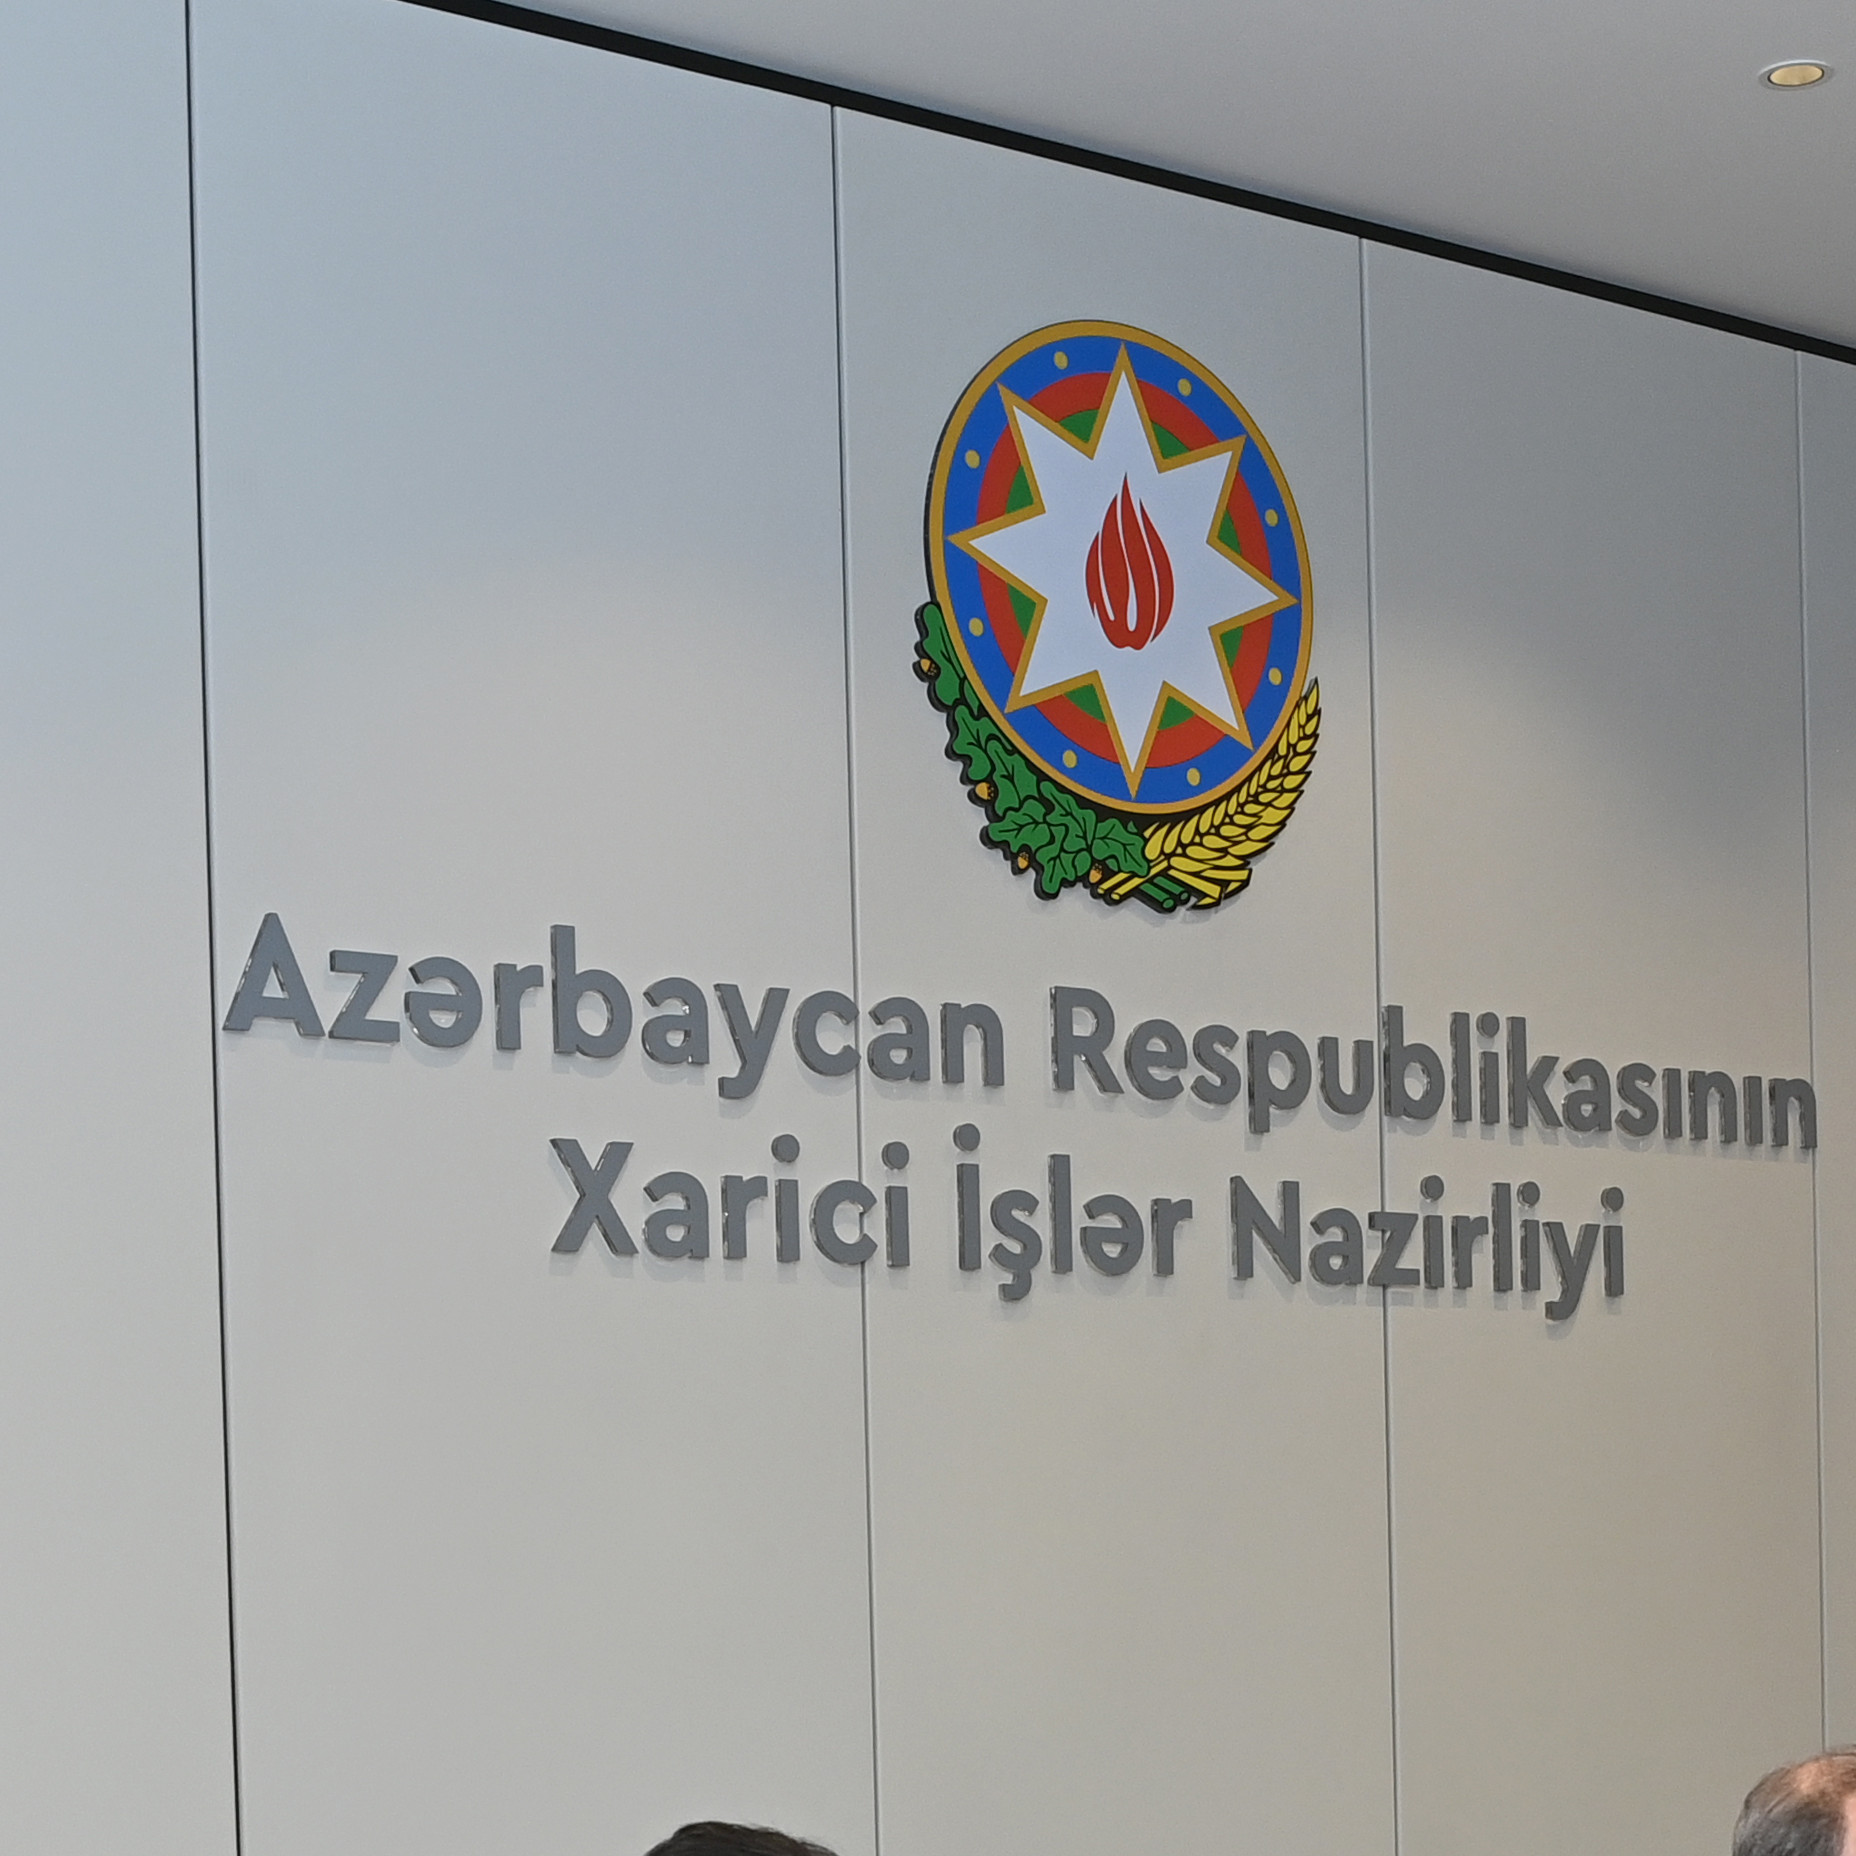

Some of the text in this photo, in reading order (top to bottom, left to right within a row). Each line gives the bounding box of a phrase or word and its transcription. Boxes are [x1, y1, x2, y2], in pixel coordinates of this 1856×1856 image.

[221, 912, 1818, 1150] Azərbaycan Respublikasının
[548, 1122, 1626, 1327] Xarici İşlər Nazirliyi
